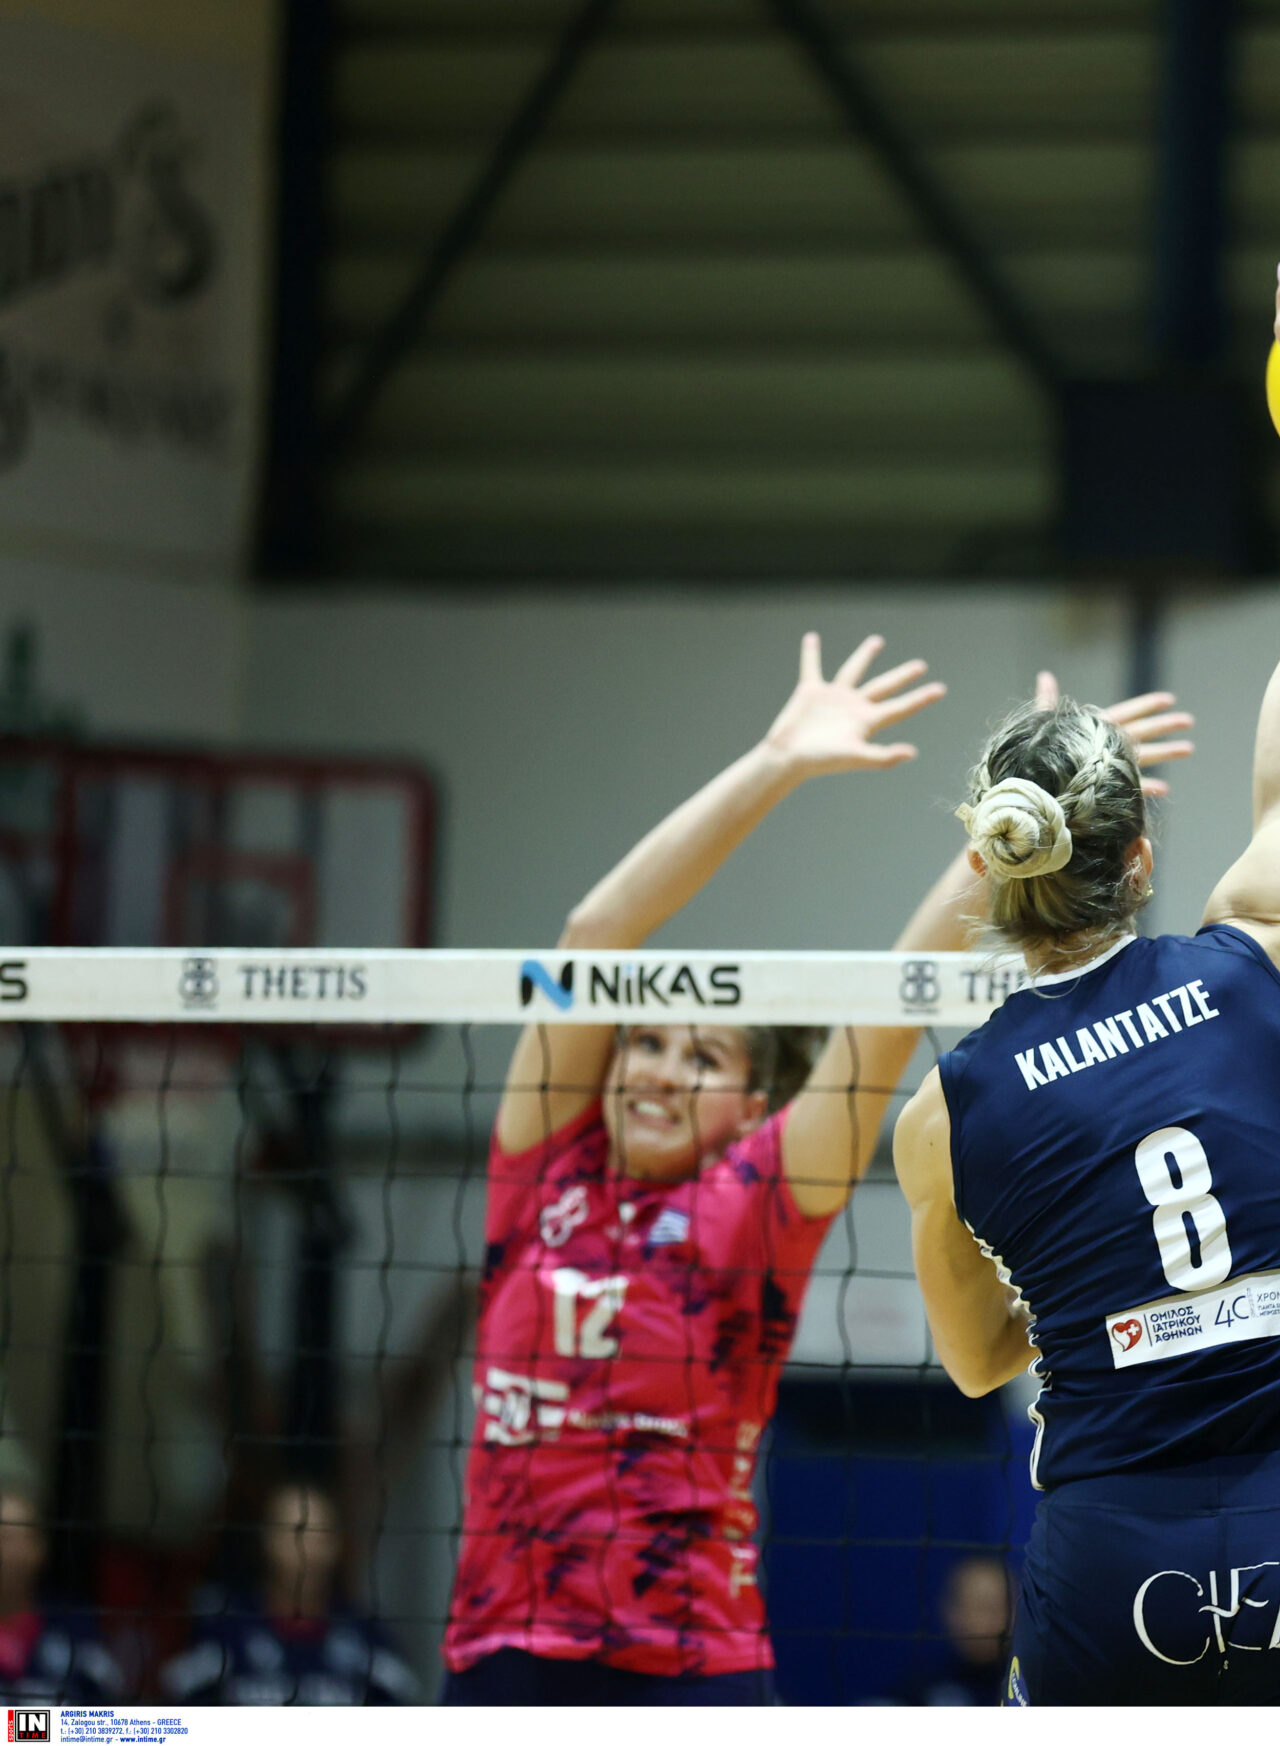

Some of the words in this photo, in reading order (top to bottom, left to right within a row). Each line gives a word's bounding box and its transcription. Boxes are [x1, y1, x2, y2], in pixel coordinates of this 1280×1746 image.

[238, 965, 368, 1000] THETIS
[1014, 979, 1220, 1091] KALANTATZE
[1134, 1126, 1233, 1292] 8
[551, 1267, 629, 1359] 12
[1150, 1305, 1195, 1323] ΟΜΙΛΟΣ
